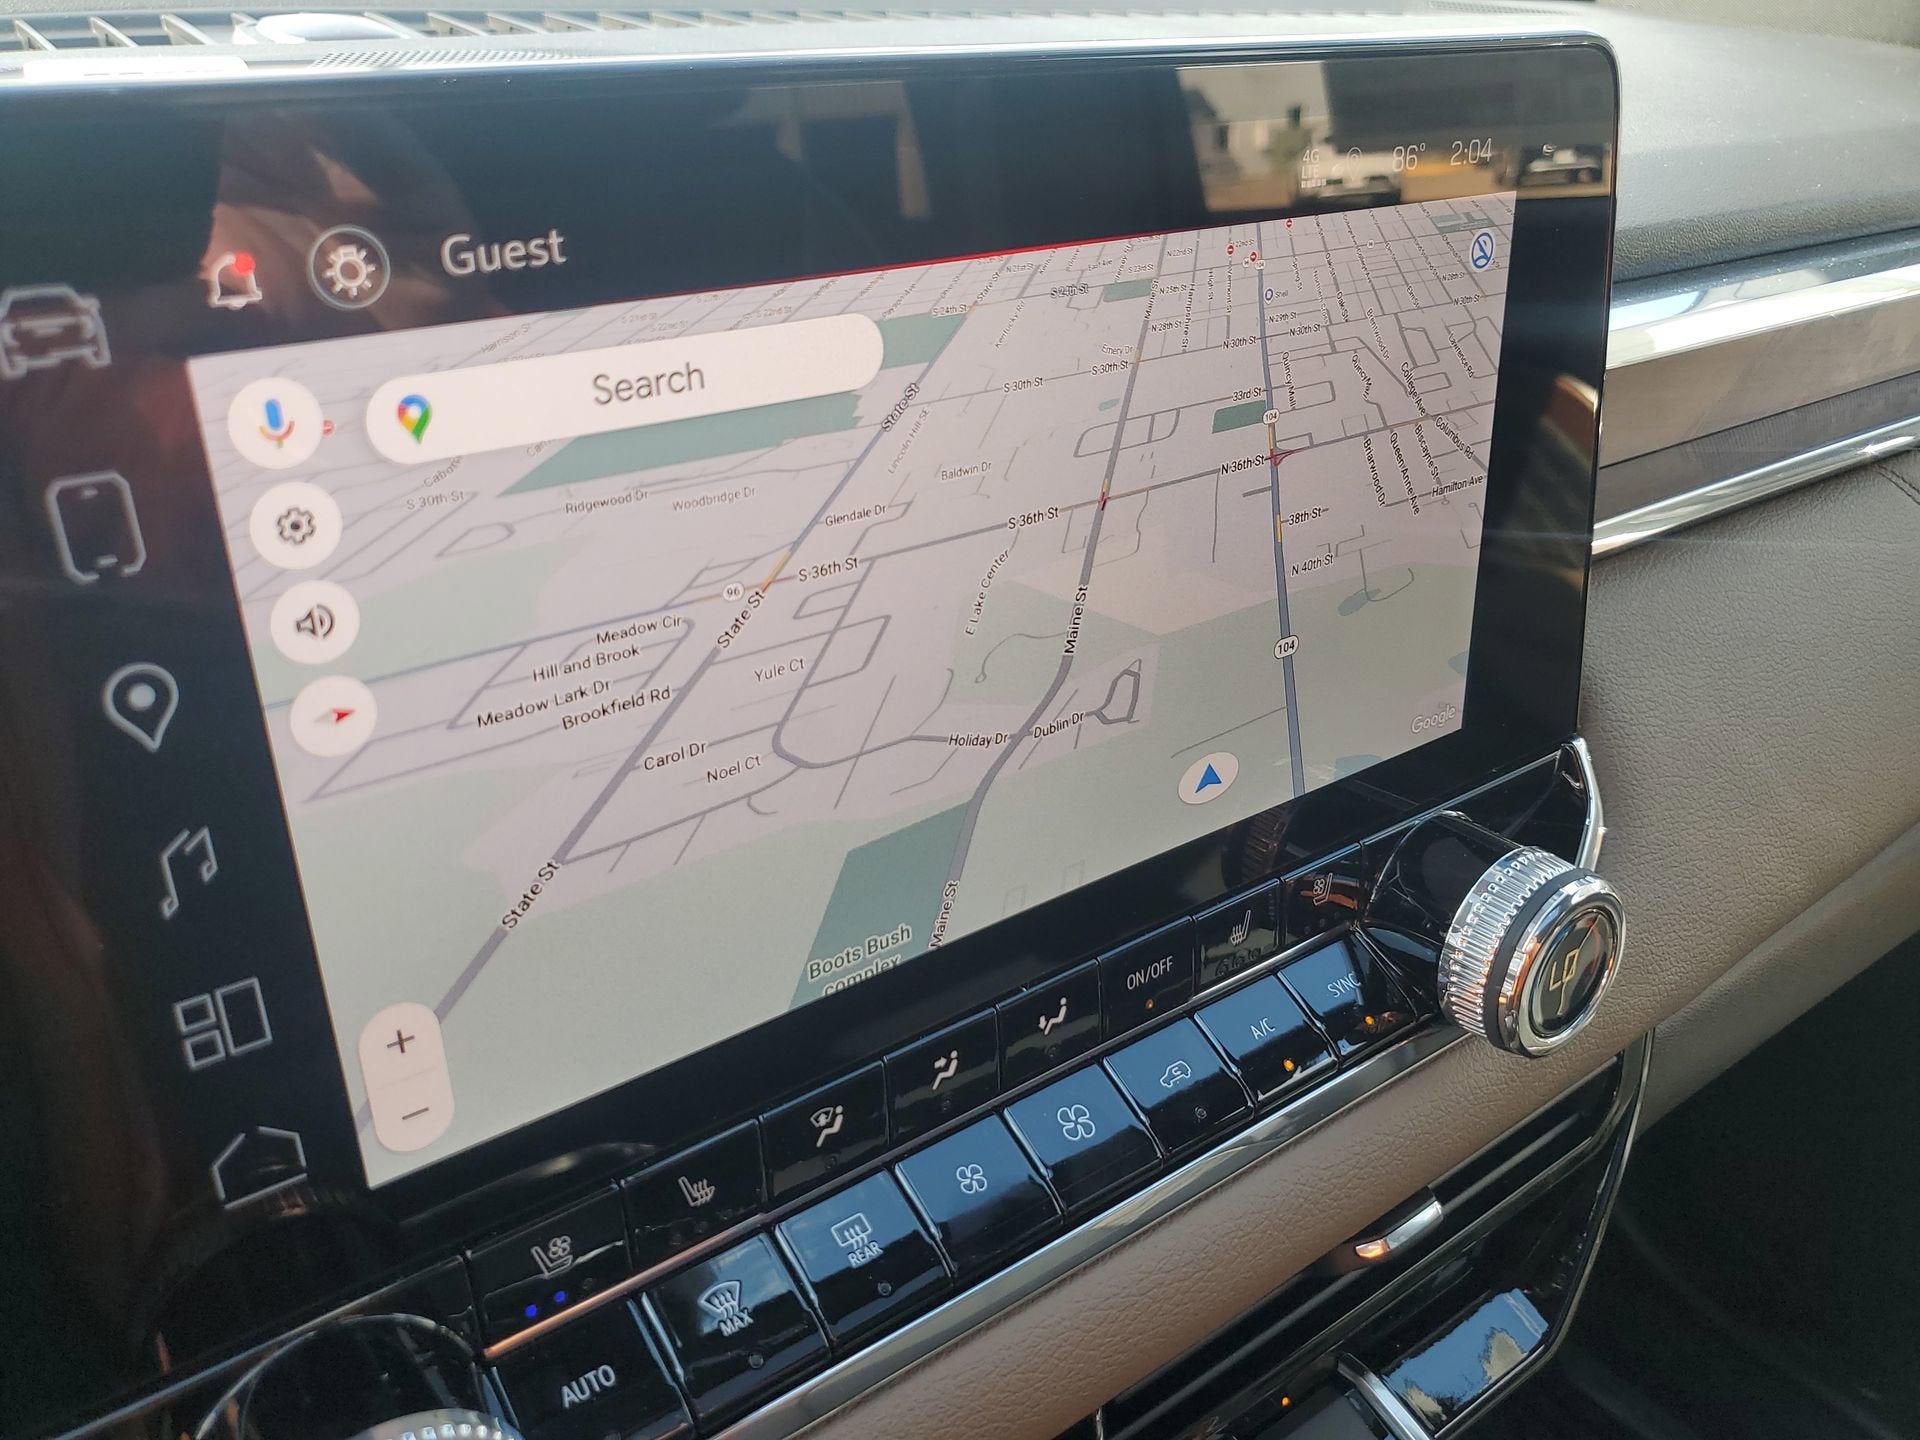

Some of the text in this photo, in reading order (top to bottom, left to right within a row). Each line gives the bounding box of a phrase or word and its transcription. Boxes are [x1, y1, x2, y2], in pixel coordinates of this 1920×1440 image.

[1303, 149, 1320, 163] 4G
[1392, 143, 1426, 172] 86°
[1450, 138, 1492, 167] 2:04
[1302, 164, 1319, 179] LTE
[441, 229, 567, 278] Guest
[1183, 283, 1196, 336] Hampshire
[1246, 332, 1257, 344] St
[1099, 362, 1117, 375] 30th
[1118, 360, 1129, 371] St
[1281, 351, 1297, 409] Quincy Mall
[593, 362, 705, 405] Search
[1011, 378, 1030, 392] 30th
[1031, 376, 1043, 388] St
[1232, 386, 1263, 402] 33rd St
[1401, 361, 1427, 416] College Ave
[881, 382, 921, 433] State St
[1264, 411, 1278, 423] 104
[1414, 424, 1434, 469] Biscayne
[1434, 416, 1475, 460] Columbus Rd
[940, 460, 993, 481] Baldwin Dr
[1220, 454, 1266, 476] N 36th St
[1363, 437, 1383, 494] Briarwood
[1389, 431, 1421, 516] Queen Anne Ave
[671, 485, 757, 512] Woodbridge Dr
[1431, 474, 1484, 498] Hamilton Ave
[406, 499, 416, 511] S
[565, 488, 650, 515] Ridgewood Dr
[825, 503, 888, 527] Glendale Dr
[1007, 506, 1060, 530] S 36th St
[1287, 507, 1323, 526] 38th St
[798, 556, 860, 583] S 36th St
[1291, 553, 1335, 576] N 40th St
[726, 586, 742, 599] 96
[965, 549, 1010, 637] E Lake Center
[595, 613, 684, 645] Meadow Cir
[716, 588, 766, 650] State St
[1064, 585, 1089, 654] Maine St
[1276, 639, 1297, 656] 104
[532, 643, 641, 682] Hill and Brook
[754, 657, 806, 682] Yule Ct
[476, 679, 612, 728] Meadow Lark Dr
[560, 684, 672, 730] Brookfield Rd
[1032, 711, 1086, 740] Dublin Dr
[1410, 704, 1457, 735] Google
[948, 732, 1009, 750] Holiday Dr
[643, 741, 708, 772] Carol Dr
[706, 754, 762, 784] Noel Ct
[500, 859, 561, 930] State St
[929, 880, 959, 949] Maine St
[808, 924, 912, 981] Boots Bush
[1126, 954, 1176, 992] ON/OFF
[1327, 970, 1363, 1000] SYNC
[1249, 1014, 1278, 1042] A/C
[846, 1241, 883, 1268] REAR
[718, 1310, 756, 1338] MAX
[560, 1362, 617, 1410] AUTO
